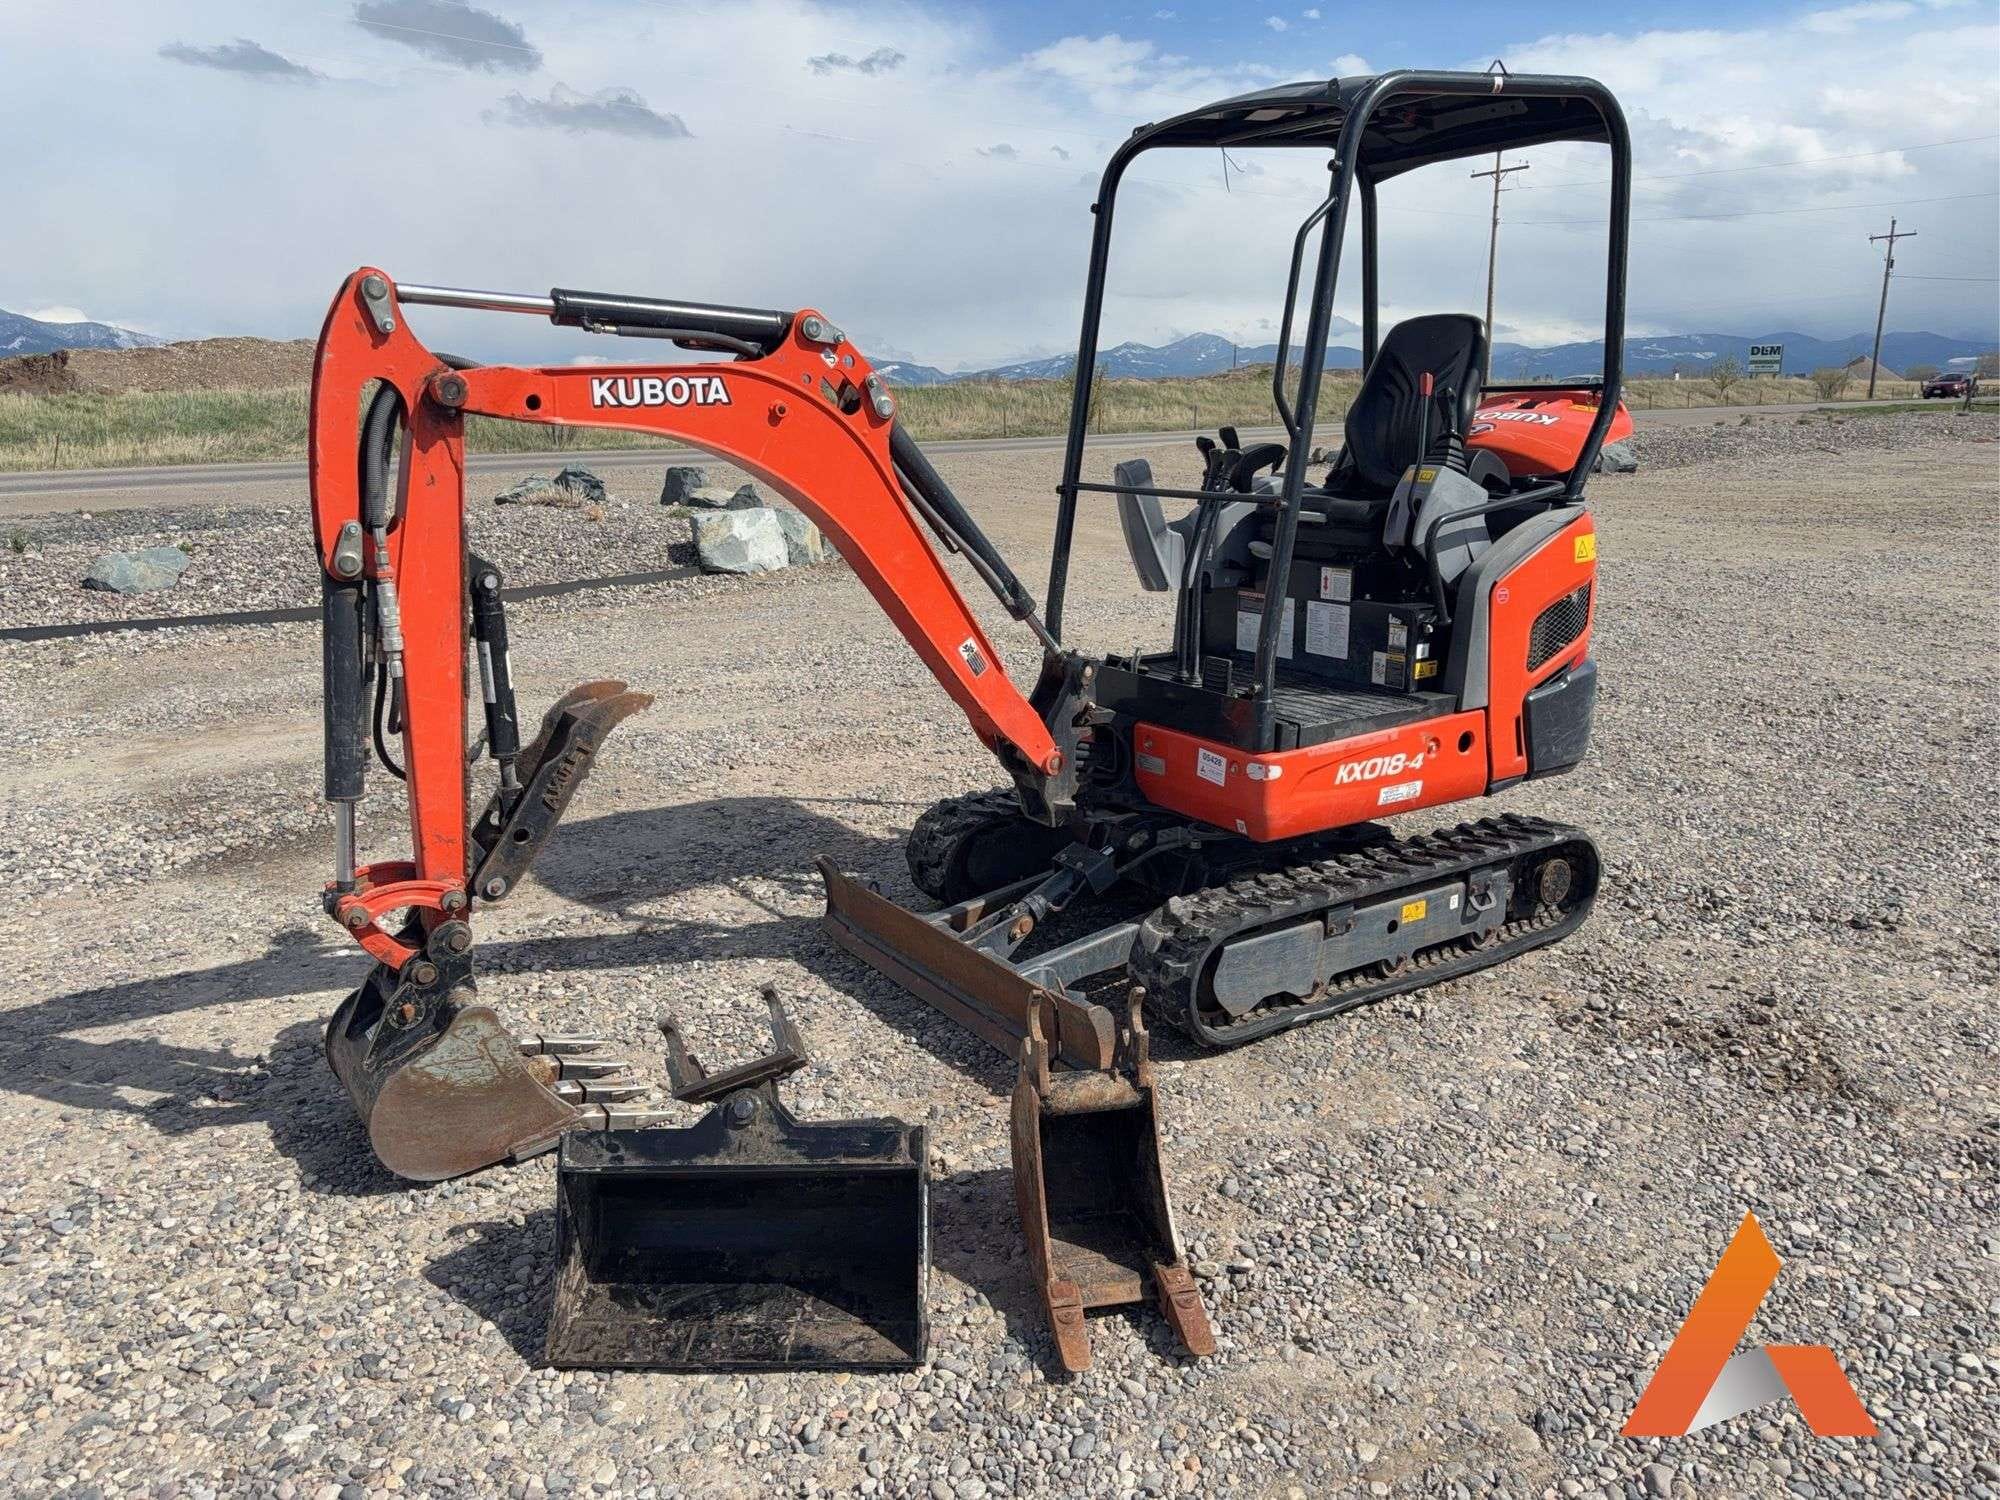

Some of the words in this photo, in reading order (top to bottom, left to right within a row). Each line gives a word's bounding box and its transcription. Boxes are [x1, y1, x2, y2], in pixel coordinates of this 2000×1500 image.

[591, 376, 730, 407] KUBOTA
[1474, 411, 1560, 426] KUBO
[1334, 752, 1424, 785] KX018-4
